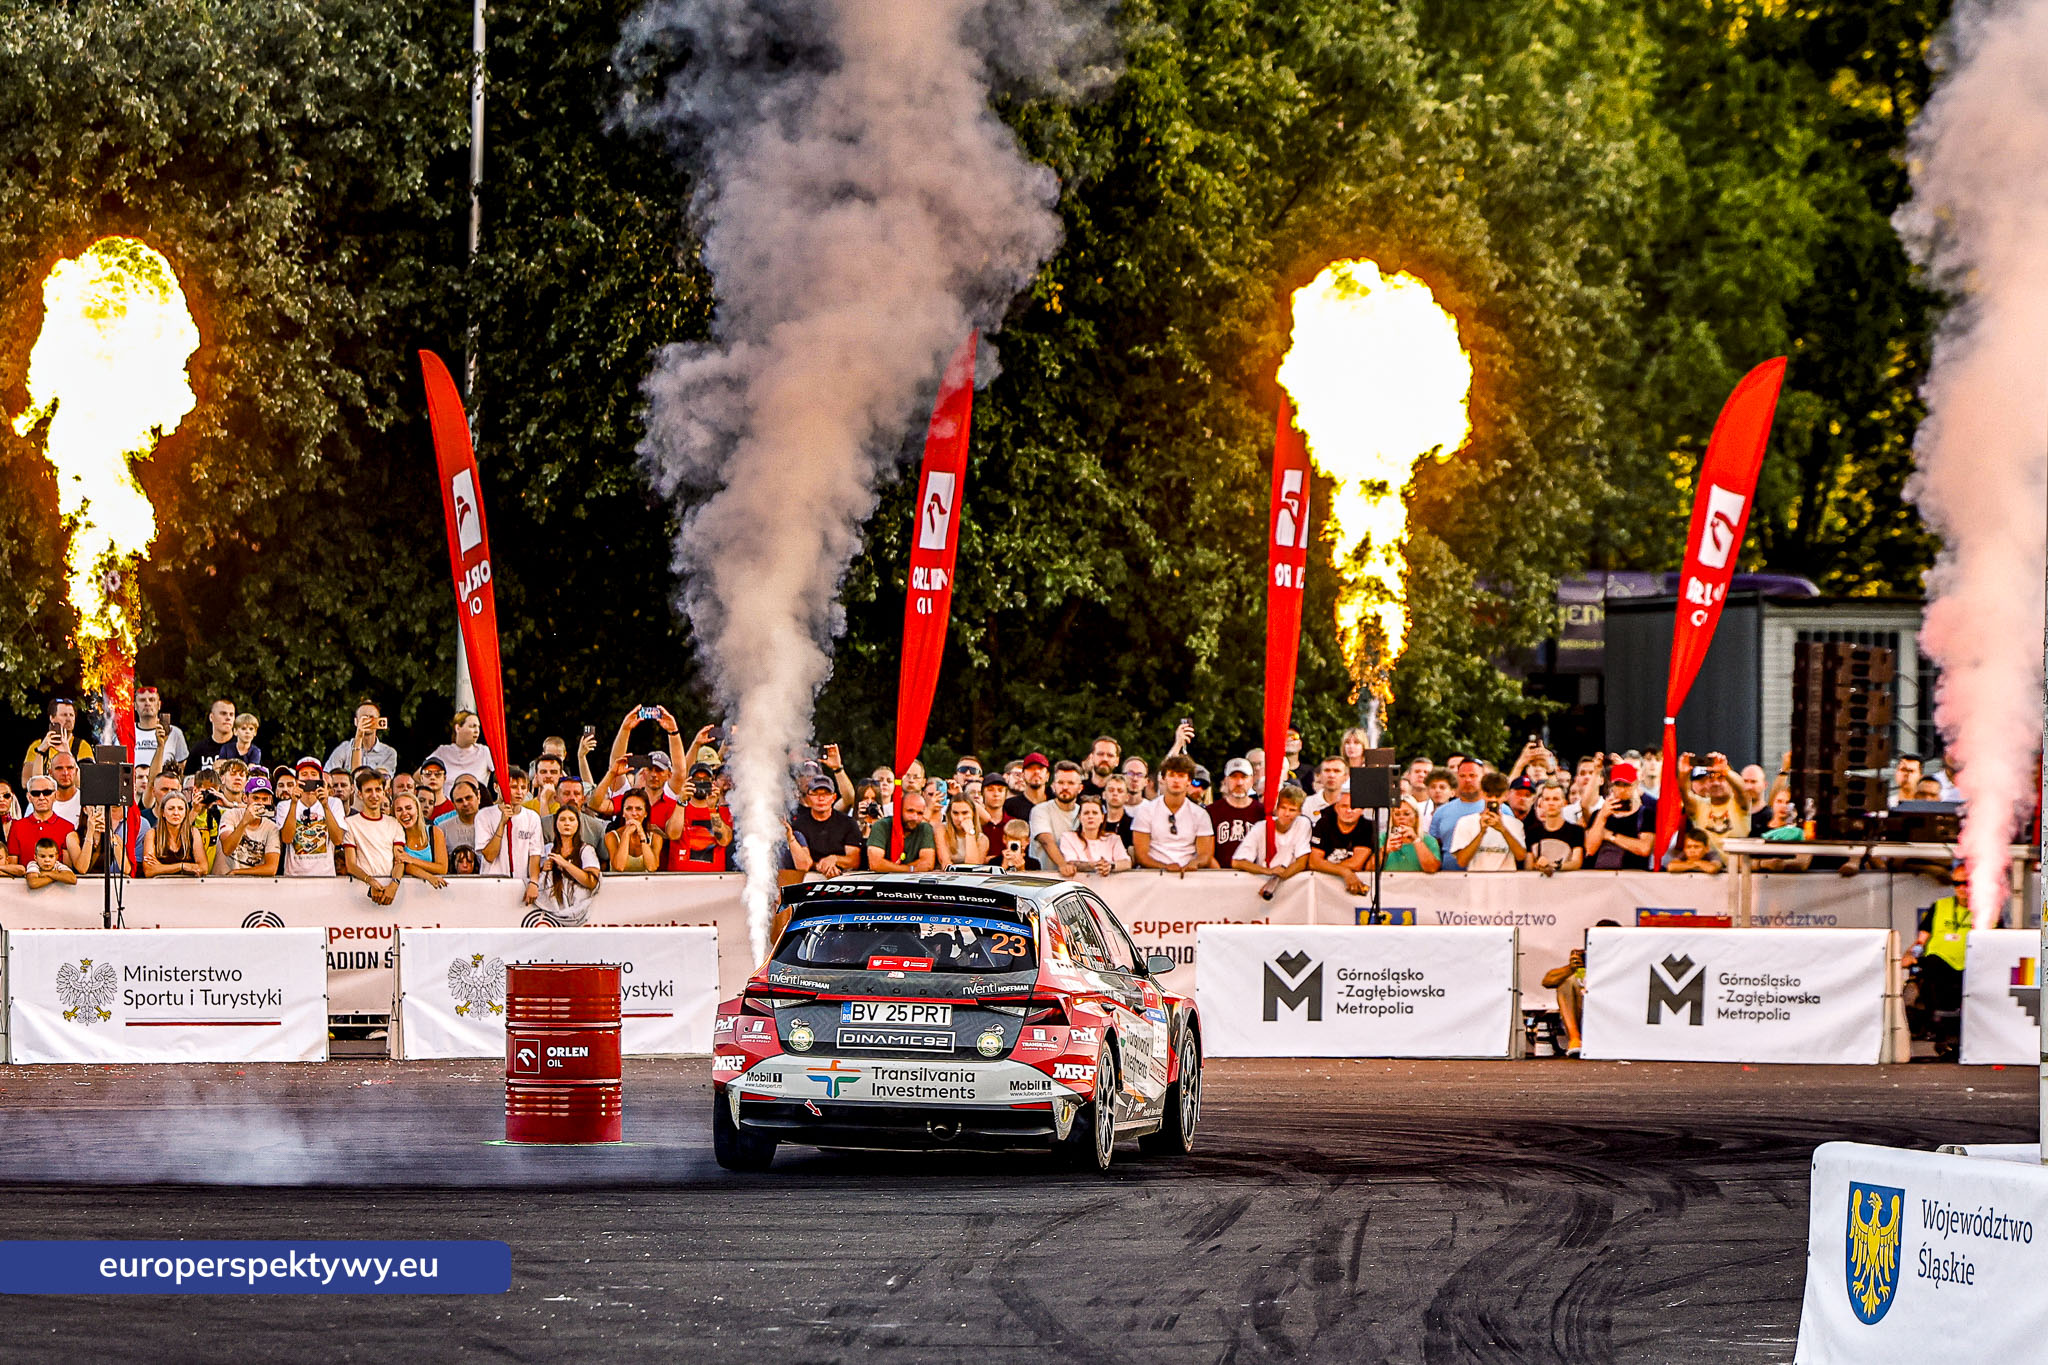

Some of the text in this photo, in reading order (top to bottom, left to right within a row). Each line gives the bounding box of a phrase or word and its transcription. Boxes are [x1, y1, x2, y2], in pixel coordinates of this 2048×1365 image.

[876, 892, 996, 904] ProRally Team Brasov
[990, 933, 1026, 957] 23
[124, 964, 242, 983] Ministerstwo
[1337, 968, 1424, 984] Górnośląsko
[1719, 972, 1801, 989] Górnośląsko
[622, 980, 673, 1000] ystyki
[801, 980, 830, 990] HOFFMAN
[998, 984, 1029, 992] HOFFMAN
[124, 986, 282, 1009] Sportu i Turystyki
[852, 1004, 880, 1021] BV
[886, 1005, 907, 1021] 25
[911, 1006, 951, 1023] PRT
[1337, 1002, 1414, 1018] Metropolia
[1718, 1007, 1791, 1023] Metropolia
[843, 1034, 949, 1046] DINAMIC92
[546, 1046, 589, 1057] ORLEN
[546, 1059, 564, 1068] OIL
[712, 1055, 746, 1071] MRF
[746, 1072, 782, 1082] Mobil 1
[871, 1067, 976, 1083] Transilvania
[1052, 1063, 1097, 1080] MRF
[871, 1083, 976, 1099] Investments
[1009, 1081, 1052, 1091] Mobil 1
[1922, 1199, 2033, 1244] Województwo
[1917, 1242, 1975, 1289] Śląskie
